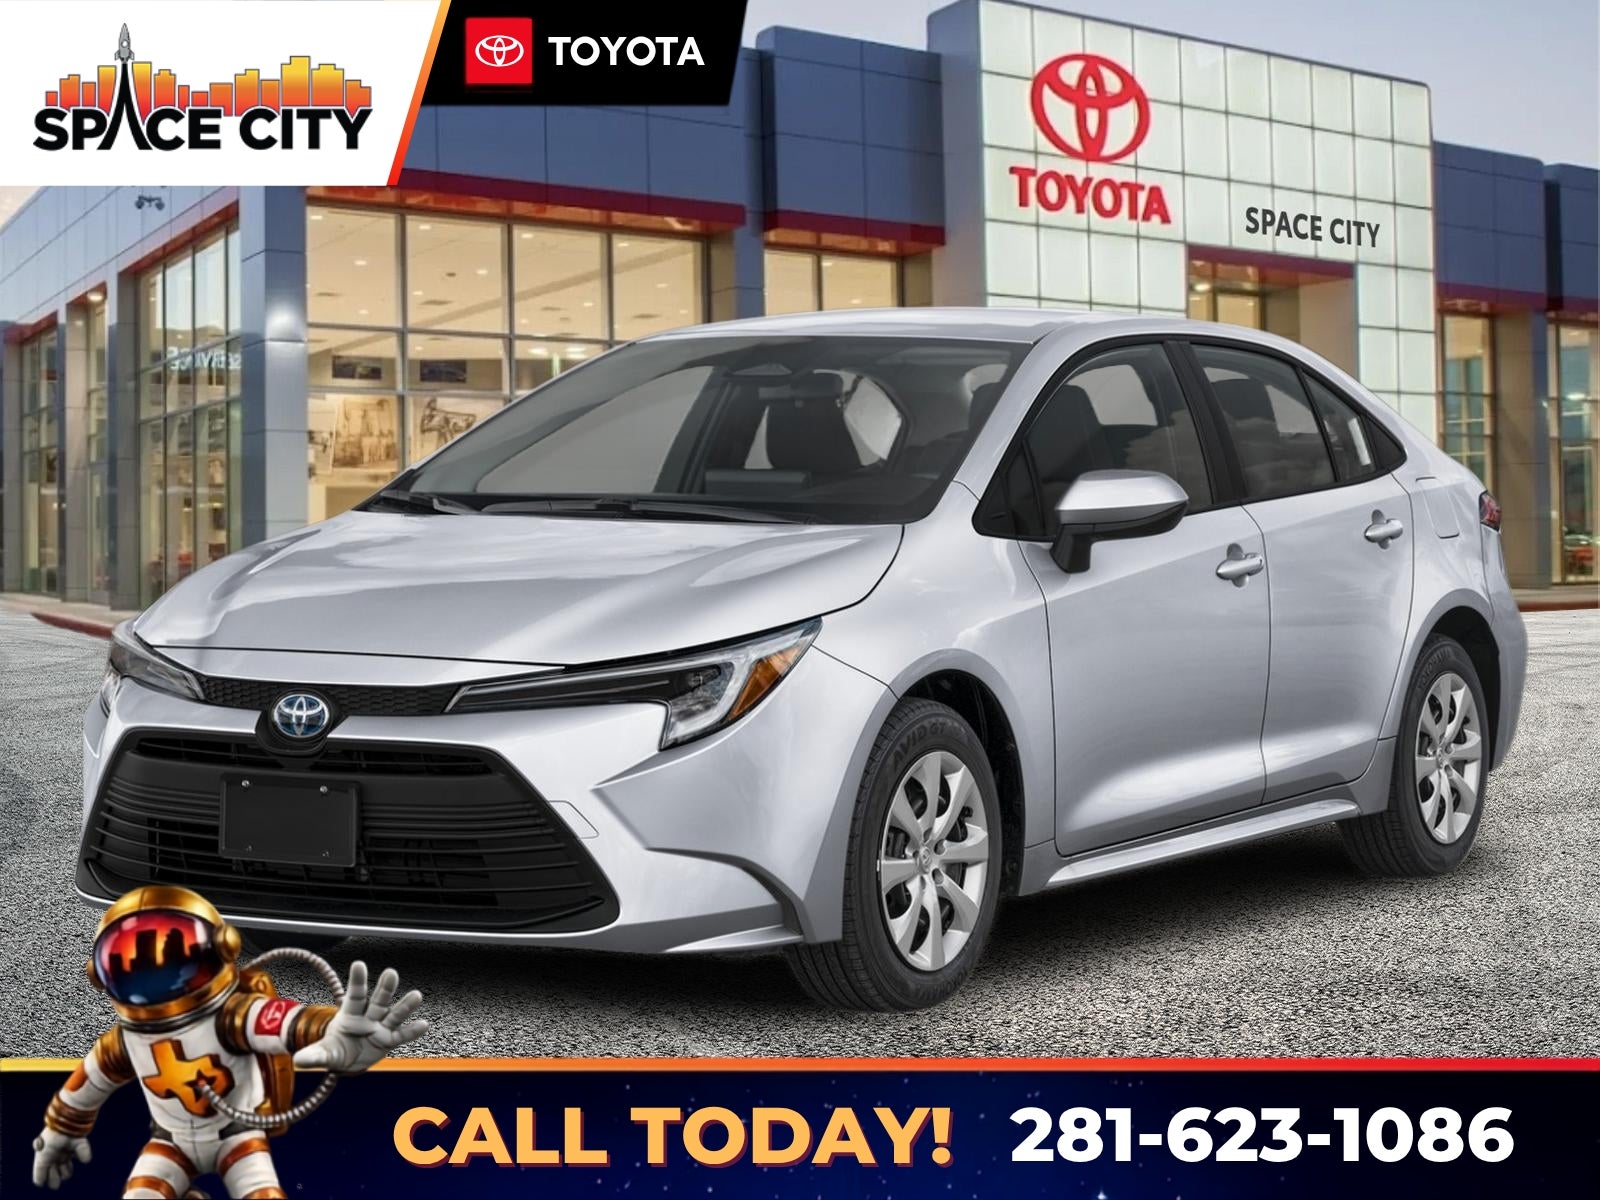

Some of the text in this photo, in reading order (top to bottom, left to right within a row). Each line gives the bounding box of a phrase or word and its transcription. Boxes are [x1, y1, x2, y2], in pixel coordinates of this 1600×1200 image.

[1009, 166, 1172, 225] TOYOTA
[1245, 206, 1381, 248] SPACE CITY
